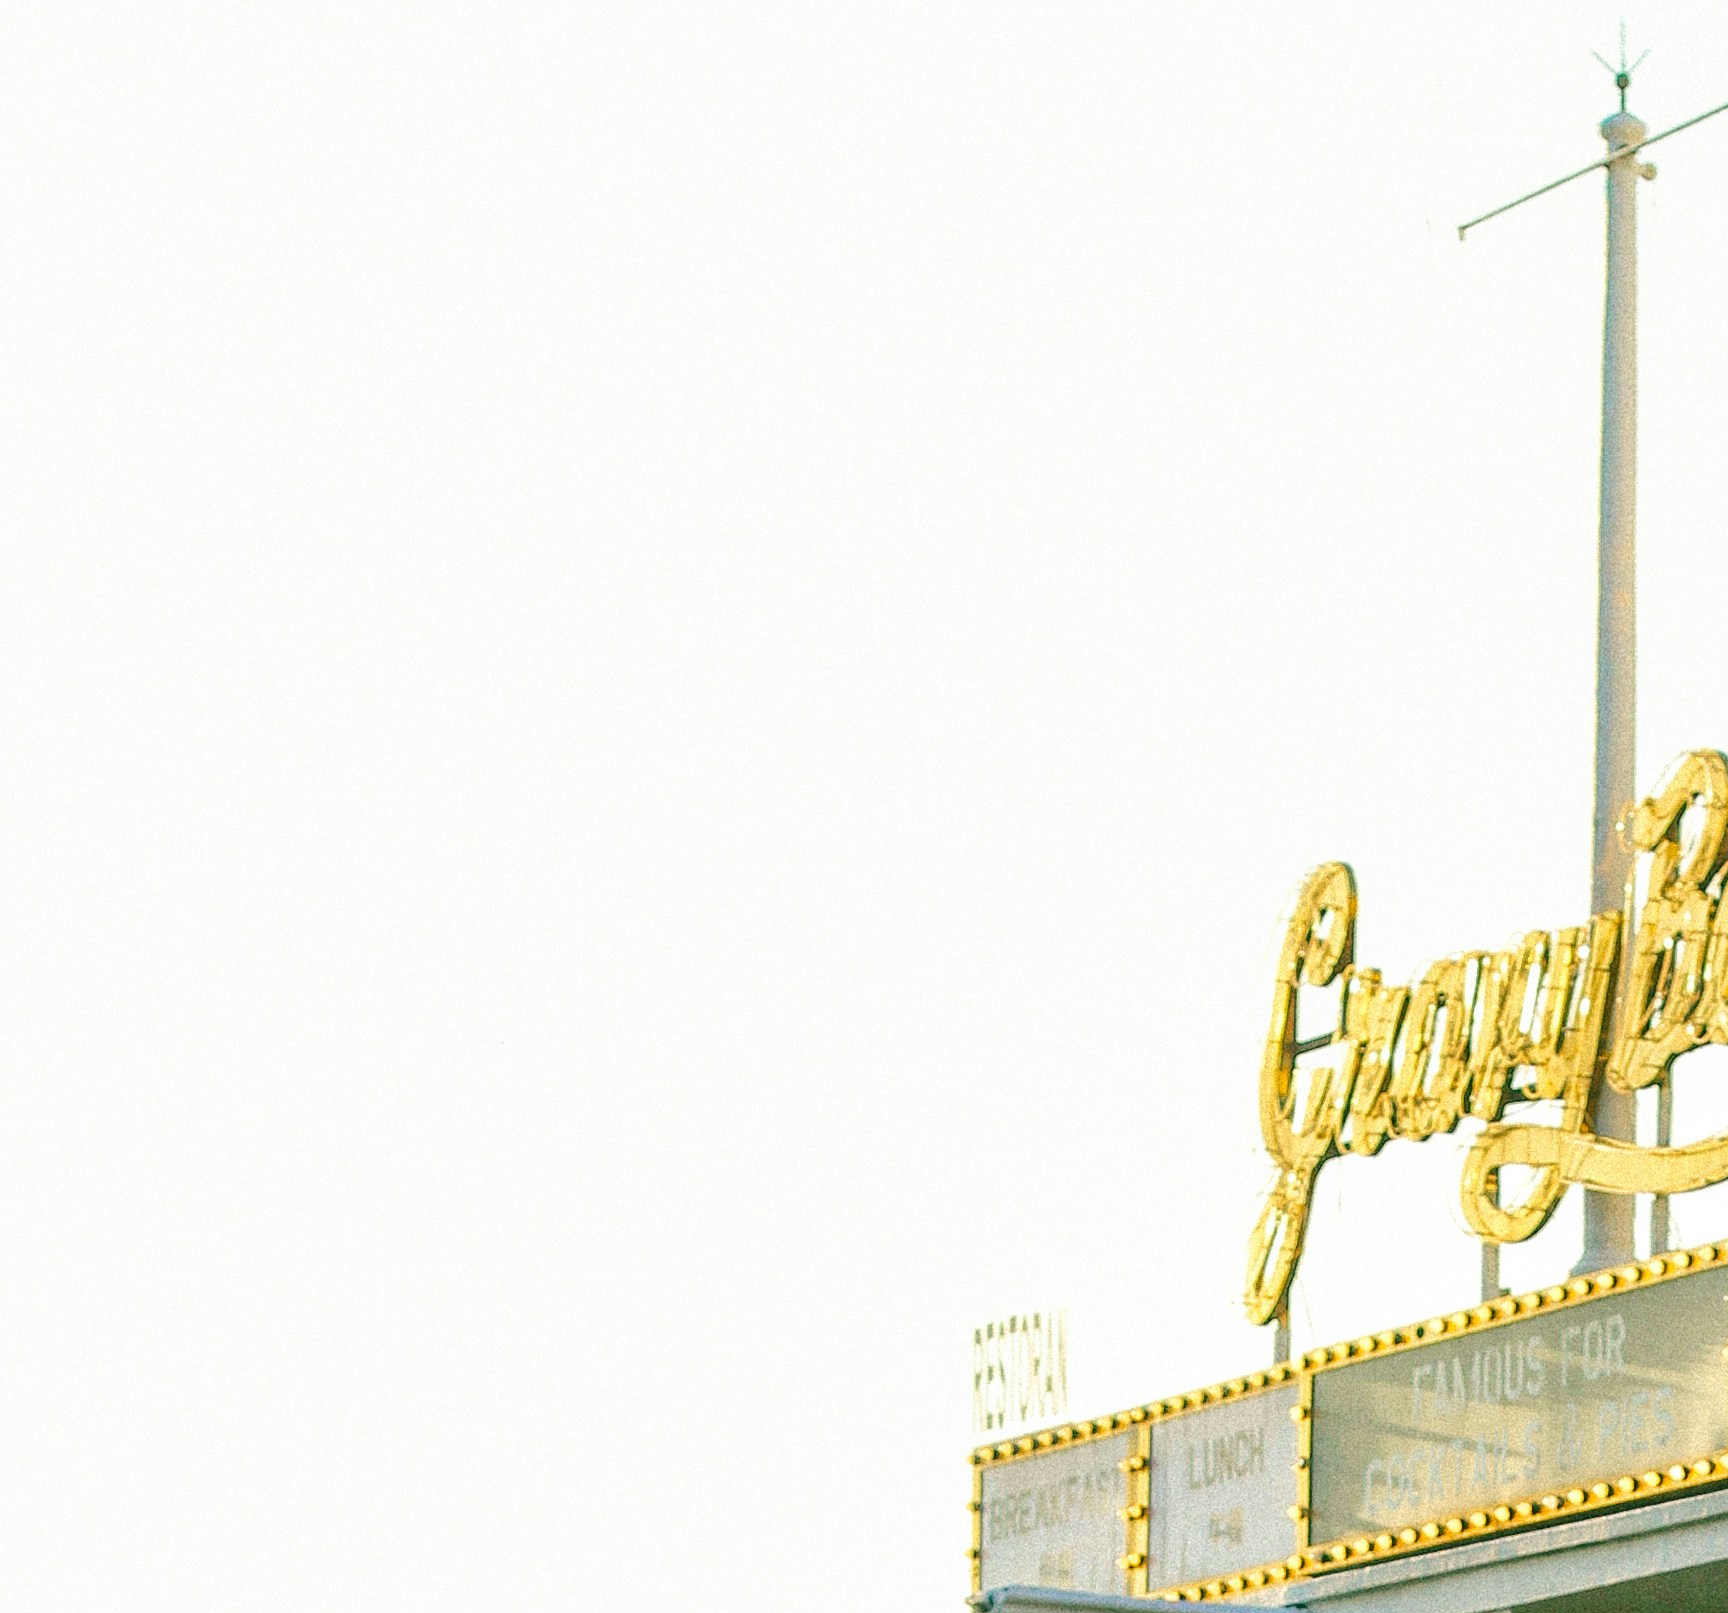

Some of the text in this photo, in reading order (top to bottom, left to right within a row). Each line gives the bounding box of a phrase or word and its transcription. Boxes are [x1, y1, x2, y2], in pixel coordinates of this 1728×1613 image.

[1411, 1313, 1627, 1425] FAMOUS FOR
[1187, 1428, 1265, 1491] LUNCH
[1364, 1420, 1542, 1517] COCKTAILS
[1599, 1386, 1676, 1456] PIES
